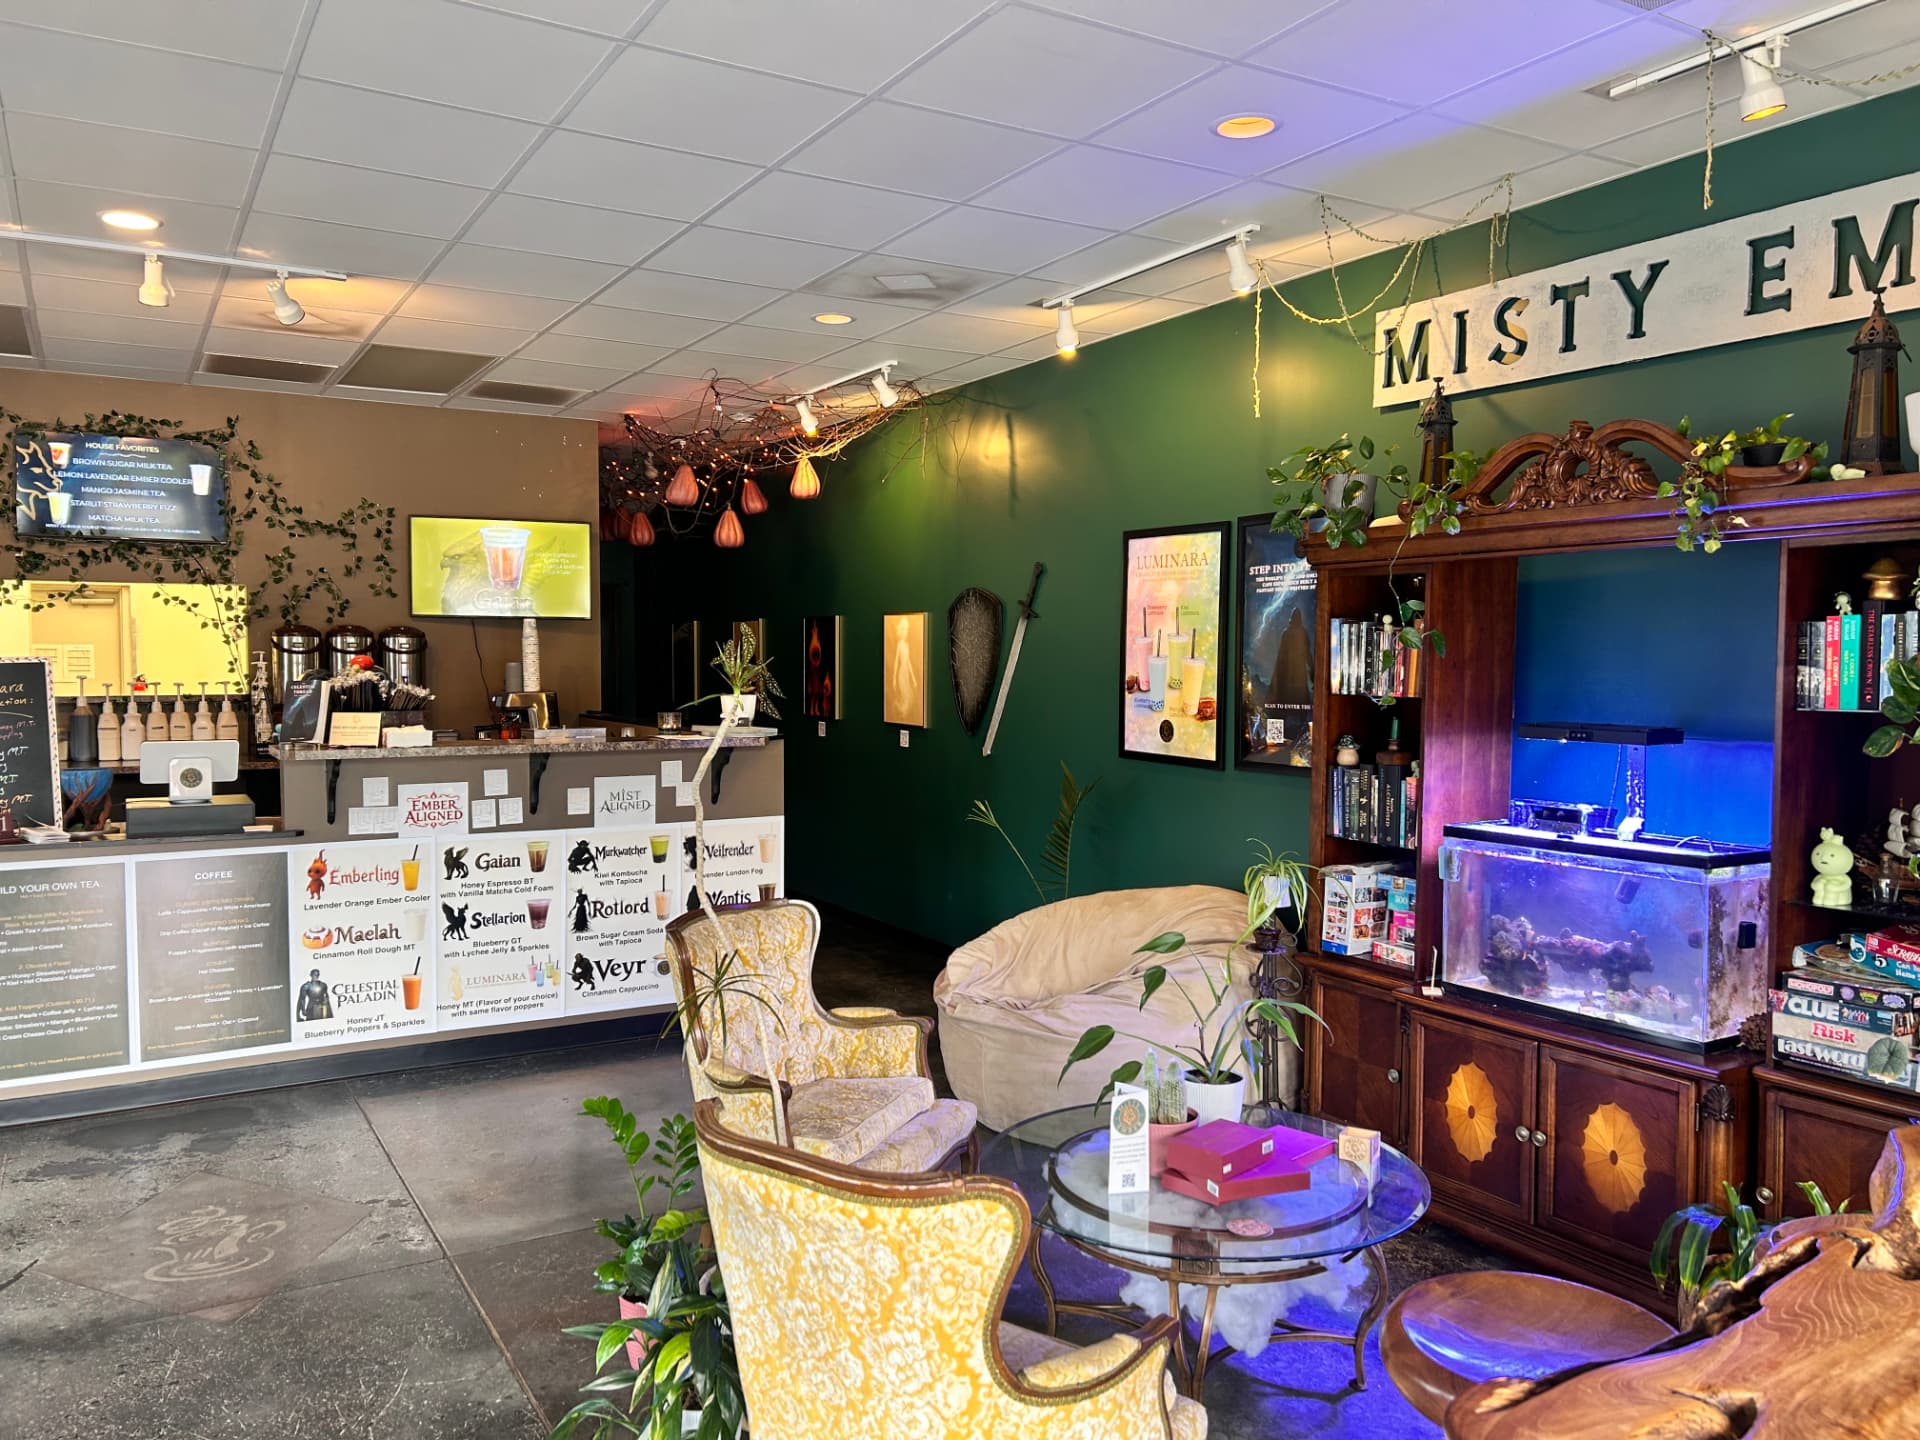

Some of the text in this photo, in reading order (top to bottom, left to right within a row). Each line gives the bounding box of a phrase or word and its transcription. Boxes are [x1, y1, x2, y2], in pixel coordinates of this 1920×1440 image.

[1382, 258, 1670, 389] MISTY
[86, 442, 160, 454] HOUSE FAVORITES
[72, 458, 106, 466] BROWN
[107, 460, 136, 468] SUGAR
[53, 470, 84, 478] LEMON
[131, 475, 160, 483] EMBER
[82, 486, 114, 494] MANGO
[114, 488, 150, 496] JASMINE
[104, 502, 158, 511] STRAWBERRY
[88, 514, 124, 522] MATCHA
[1136, 552, 1208, 570] LUMINARA
[1249, 564, 1270, 576] STEP
[1272, 563, 1296, 574] INTO
[610, 788, 640, 801] MIST
[412, 800, 457, 812] EMBER
[600, 800, 650, 814] ALIGNED
[404, 809, 464, 824] ALIGNED
[594, 845, 648, 862] Murkwatcher
[704, 840, 754, 859] Veilrender
[475, 853, 521, 872] Gaian
[194, 870, 232, 880] COFFEE
[328, 864, 400, 886] Emberling
[610, 868, 648, 878] Kombucha
[19, 884, 50, 893] YOUR
[52, 882, 77, 891] OWN
[80, 880, 100, 888] TEA
[461, 880, 485, 890] Honey
[487, 878, 522, 888] Espresso
[616, 878, 643, 886] Tapioca
[458, 889, 484, 898] Vanilla
[486, 887, 512, 896] Matcha
[514, 886, 532, 894] Cold
[533, 884, 554, 892] Foam
[304, 894, 430, 910] Lavender Orange Ember Cooler
[591, 897, 650, 918] Rotlord
[470, 912, 526, 930] Stellarion
[334, 924, 402, 944] Maelah
[576, 934, 598, 942] Brown
[600, 931, 620, 940] Sugar
[622, 929, 645, 937] Cream
[472, 938, 509, 948] Blueberry
[614, 938, 642, 946] Tapioca
[312, 951, 354, 960] Cinnamon
[356, 948, 374, 956] Roll
[376, 944, 402, 956] Dough
[444, 950, 460, 958] with
[462, 948, 488, 958] Lychee
[490, 946, 508, 956] Jelly
[518, 943, 550, 952] Sparkles
[1874, 954, 1887, 968] 5
[593, 958, 647, 982] Veyr
[466, 973, 526, 986] LUMINARA
[331, 979, 399, 996] CELESTIAL
[582, 982, 660, 998] Cinnamon Cappuccino
[338, 990, 397, 1008] PALADIN
[437, 1002, 460, 1012] Honey
[462, 1000, 474, 1008] MT
[476, 998, 502, 1008] (Flavor
[513, 996, 530, 1004] your
[532, 992, 558, 1000] choice)
[451, 1002, 544, 1018] with same flavor poppers
[1788, 996, 1840, 1022] CLUE
[346, 1014, 384, 1027] Honey JT
[304, 1028, 344, 1039] Blueberry
[347, 1024, 381, 1034] Poppers
[390, 1018, 426, 1028] Sparkles
[1812, 1022, 1856, 1044] Risk
